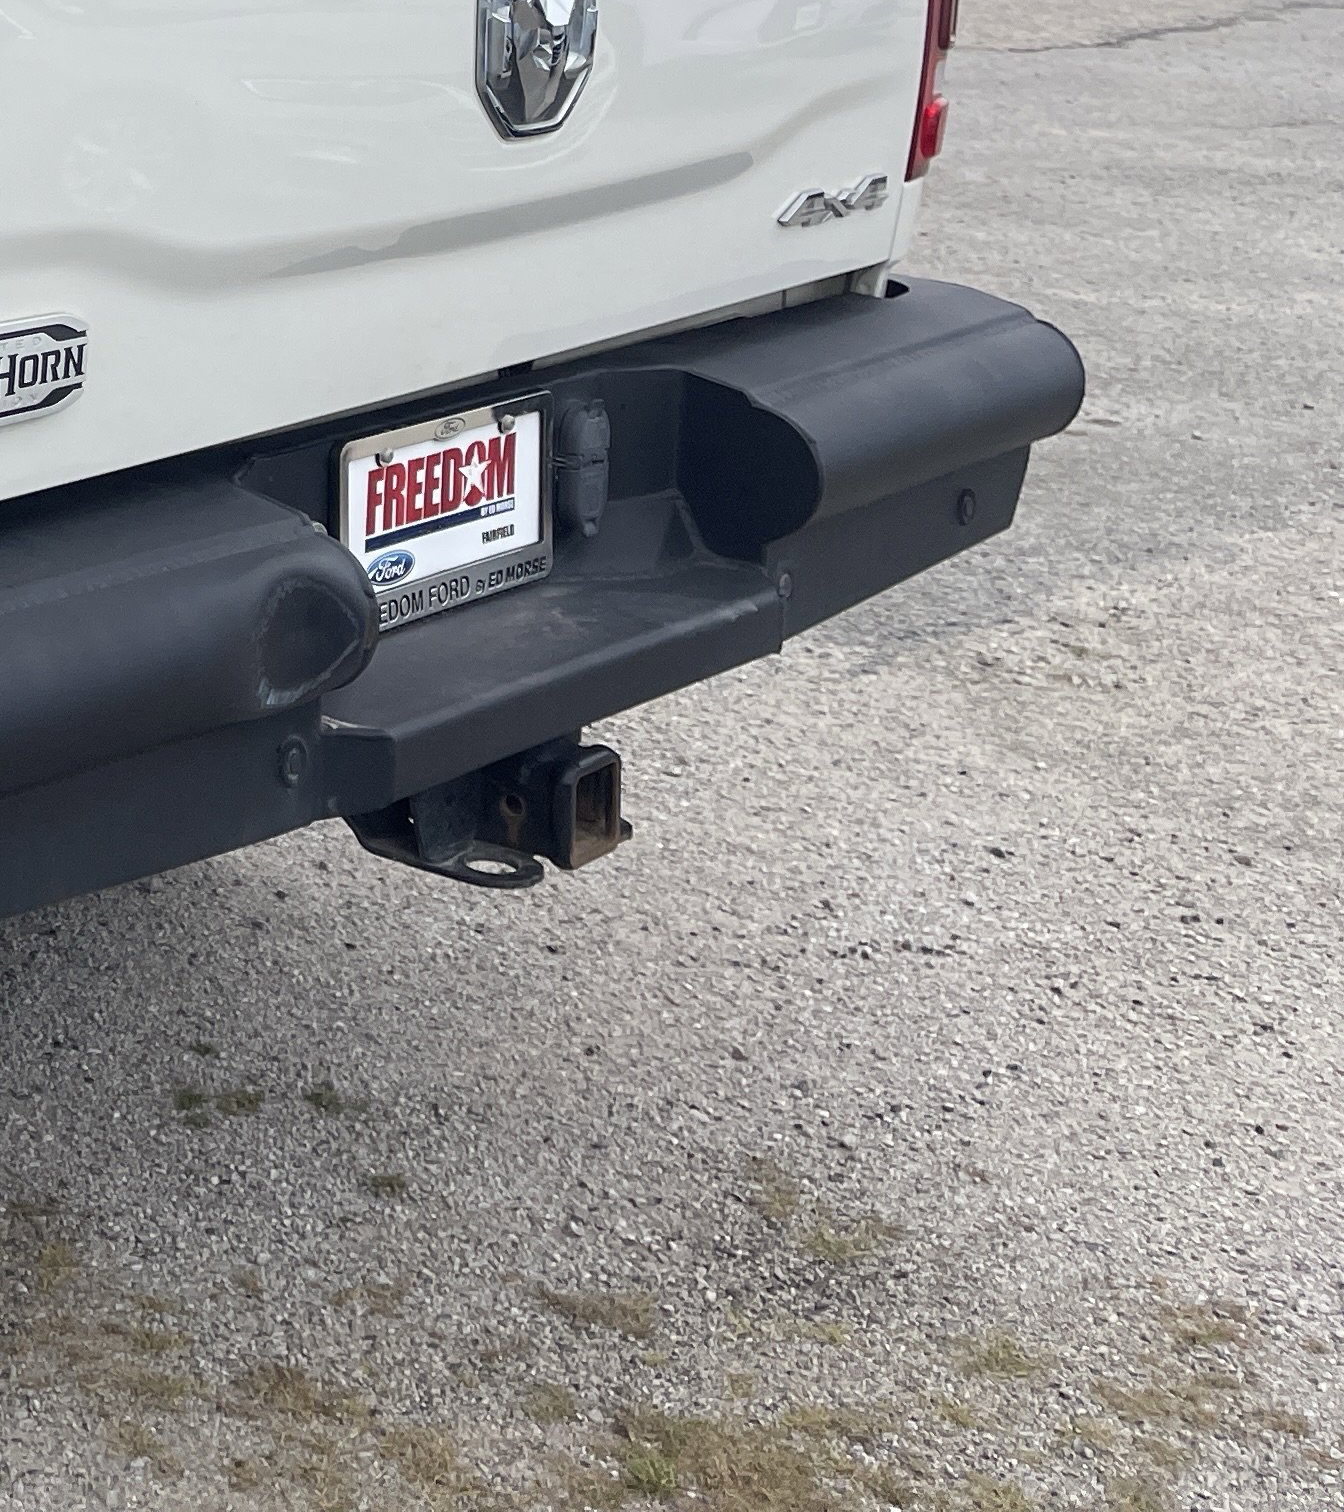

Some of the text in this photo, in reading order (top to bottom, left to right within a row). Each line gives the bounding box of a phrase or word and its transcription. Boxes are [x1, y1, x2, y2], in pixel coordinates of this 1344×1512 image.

[365, 432, 517, 536] FREEDOM
[367, 556, 407, 582] Ford
[429, 575, 470, 608] FORD
[488, 569, 503, 588] ED
[505, 555, 547, 583] MORSE
